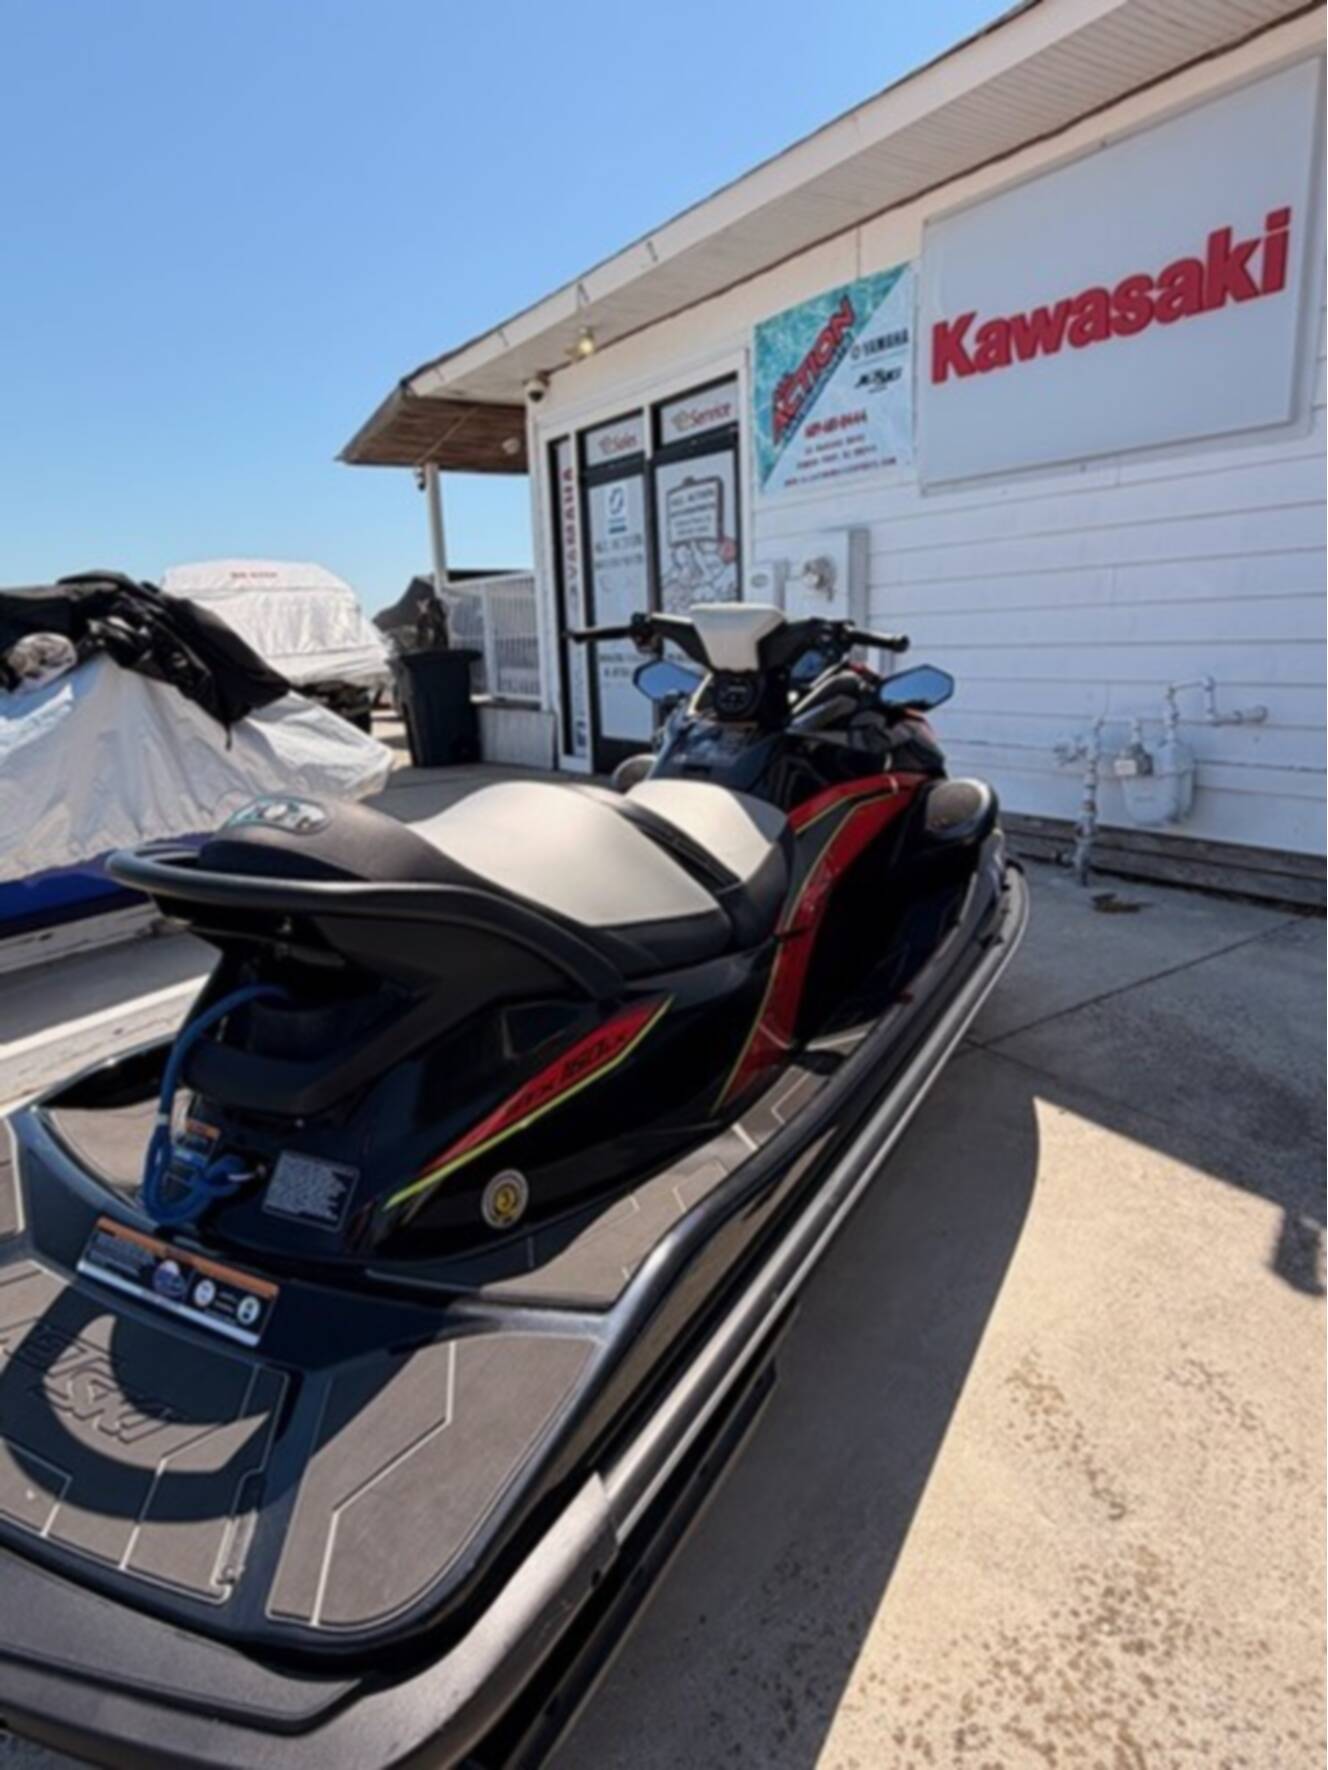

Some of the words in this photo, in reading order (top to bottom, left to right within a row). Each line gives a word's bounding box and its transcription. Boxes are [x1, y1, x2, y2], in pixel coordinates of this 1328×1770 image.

[772, 293, 855, 447] ACTION
[862, 328, 909, 355] YAMAHA
[931, 206, 1292, 384] Kawasaki
